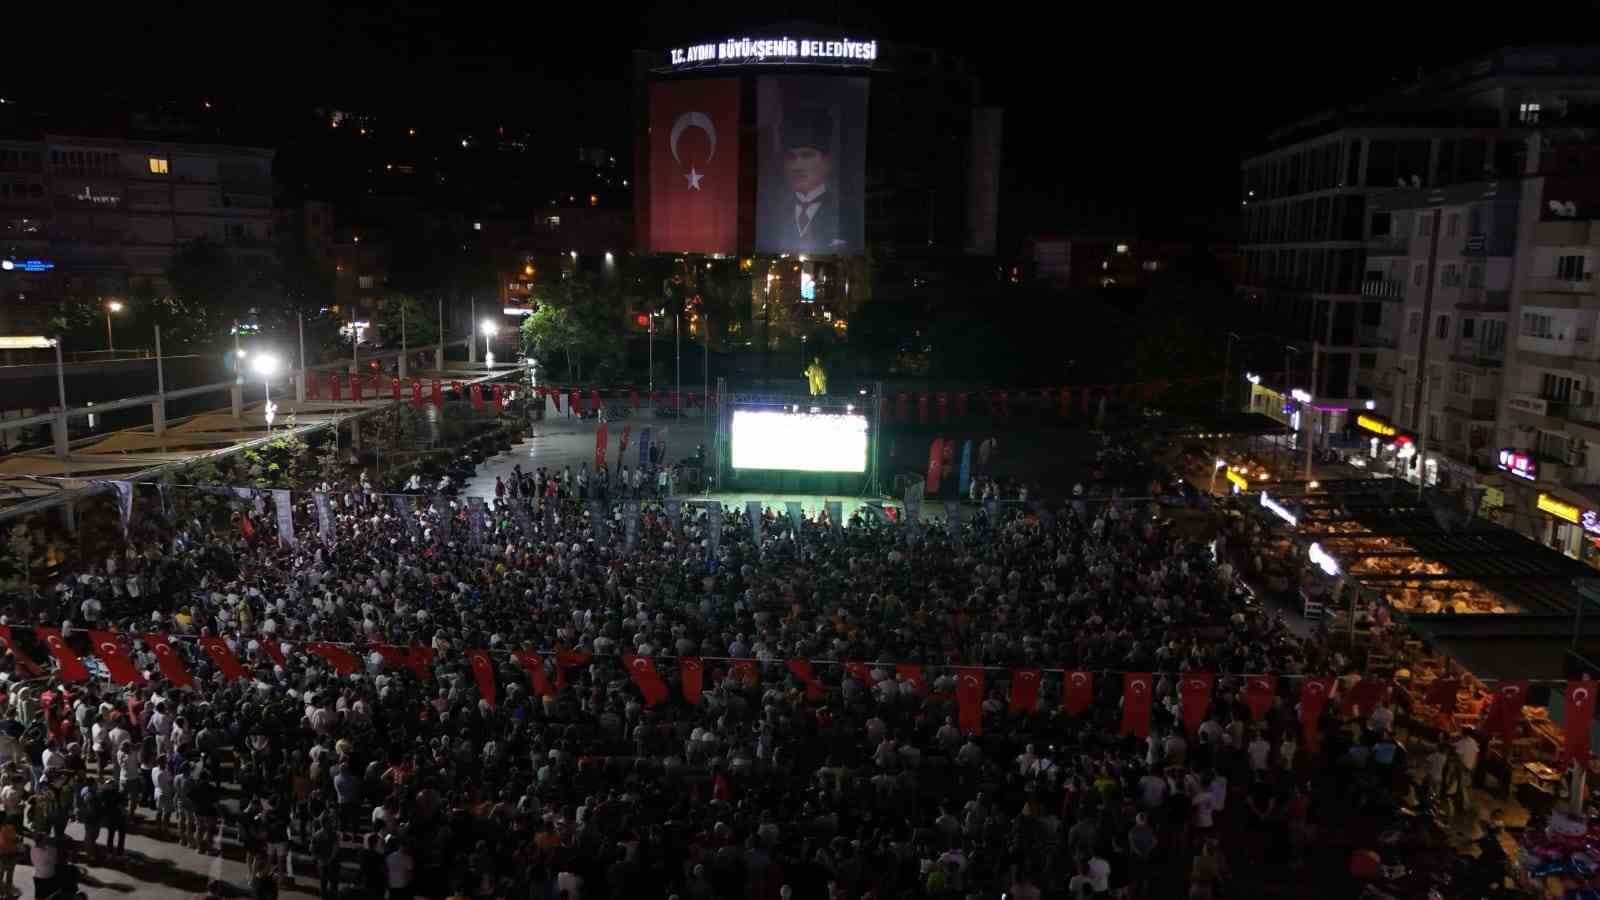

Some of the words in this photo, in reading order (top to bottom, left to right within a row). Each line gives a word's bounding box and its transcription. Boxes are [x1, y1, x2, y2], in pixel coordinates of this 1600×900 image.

[671, 49, 686, 64] T.C.
[688, 44, 716, 62] AYDIN
[719, 37, 797, 60] BÜYÜKŞEHİR
[801, 38, 877, 59] BELEDİYESİ
